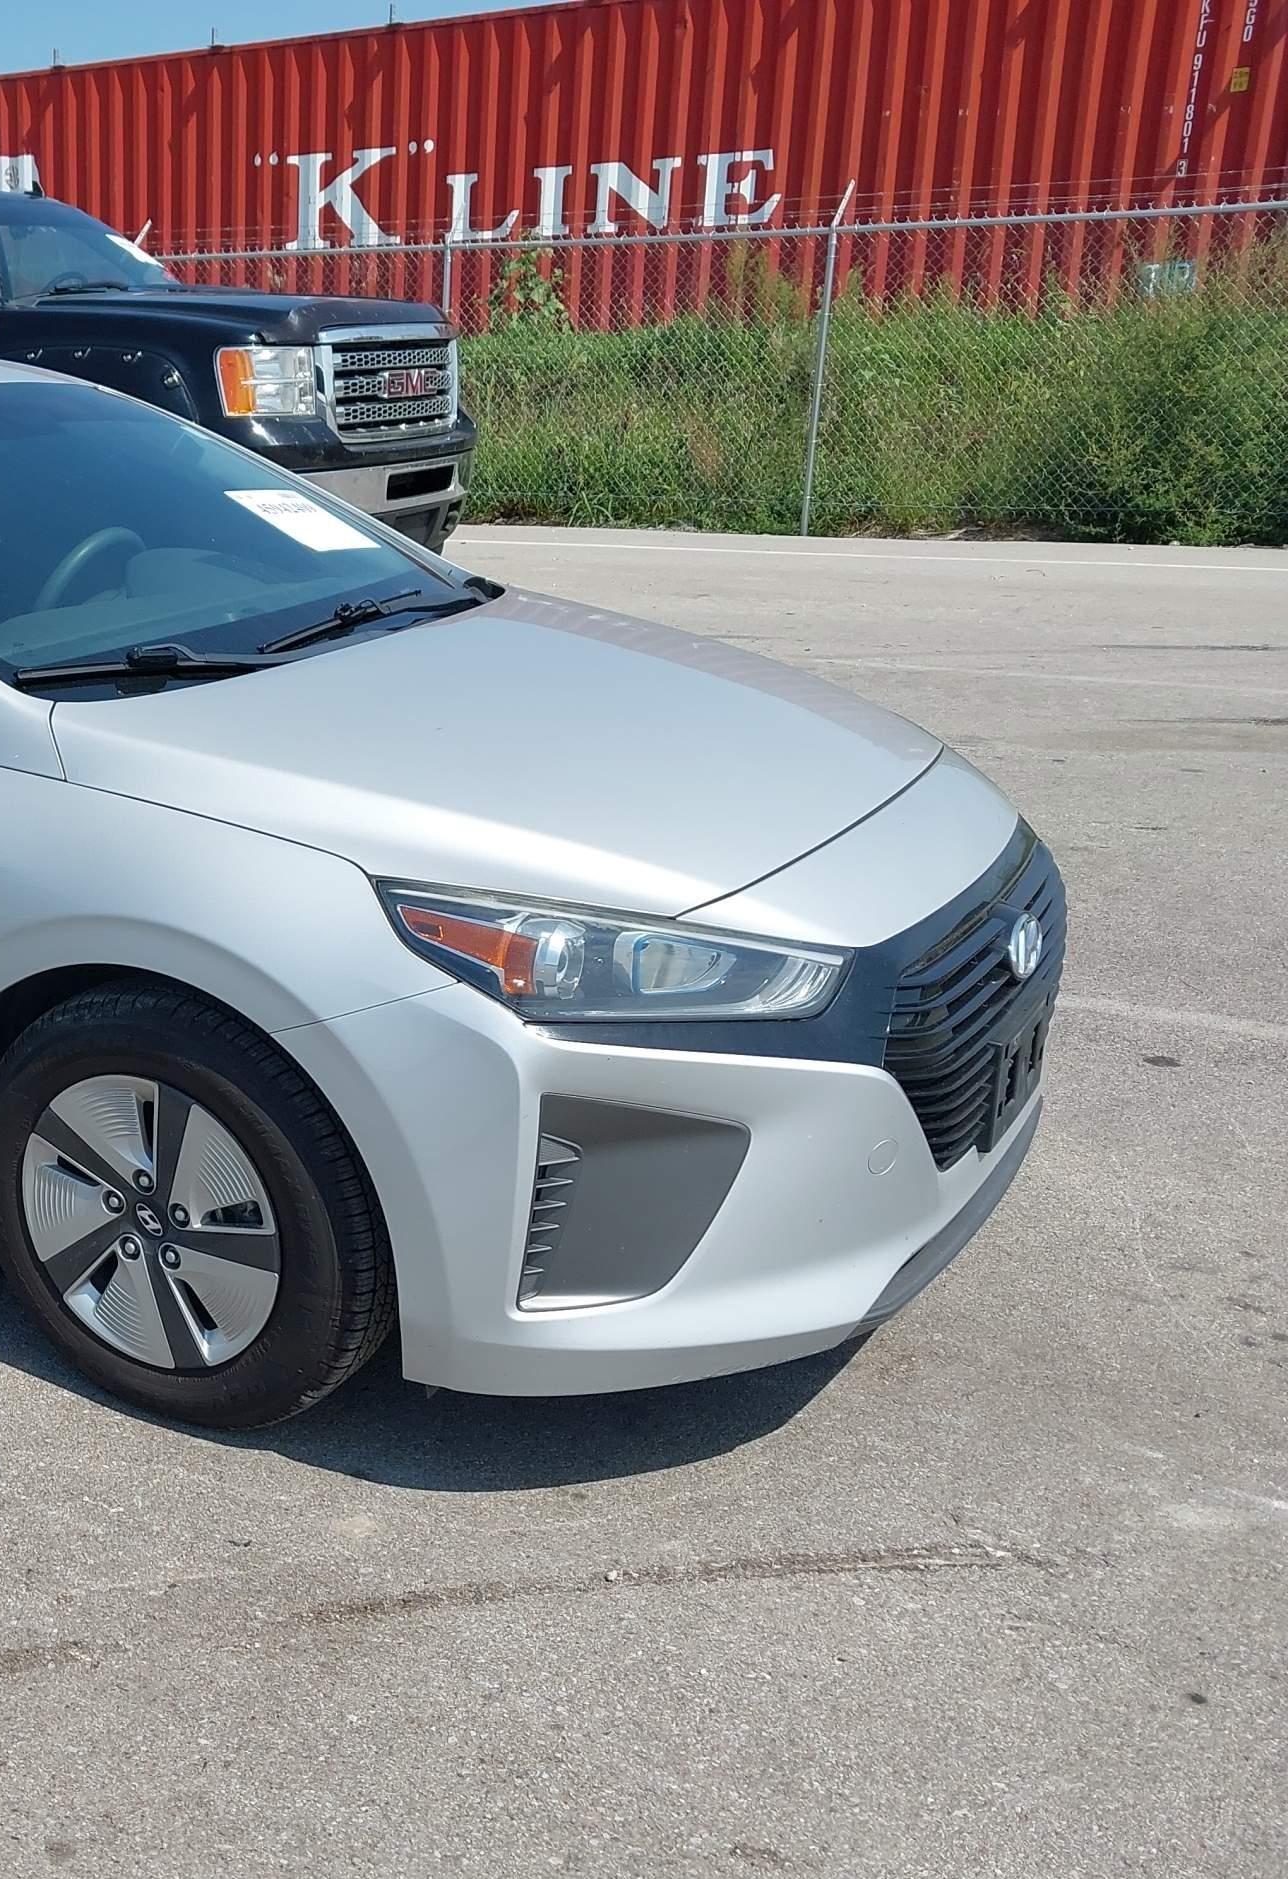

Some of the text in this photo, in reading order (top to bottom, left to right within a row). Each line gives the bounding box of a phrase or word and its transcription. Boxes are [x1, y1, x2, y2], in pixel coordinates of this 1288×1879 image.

[1182, 54, 1203, 153] 911801
[446, 149, 782, 242] LINE
[1177, 160, 1187, 177] 3
[387, 368, 440, 398] GMC
